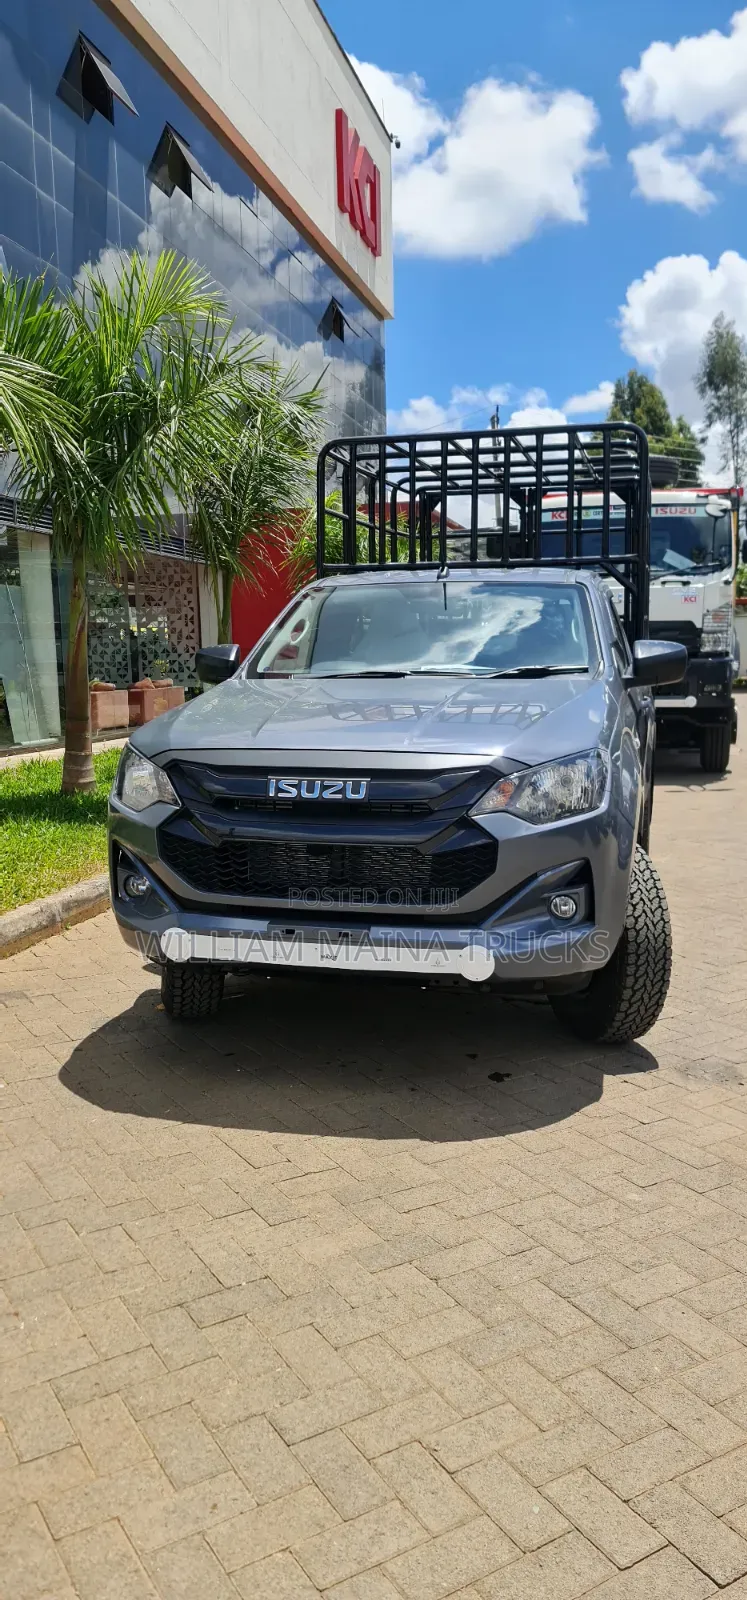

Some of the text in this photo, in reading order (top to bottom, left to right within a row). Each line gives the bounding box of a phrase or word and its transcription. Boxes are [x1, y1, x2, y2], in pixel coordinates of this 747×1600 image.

[335, 108, 381, 257] KCI
[551, 511, 568, 520] KC
[654, 507, 697, 515] ISUZU
[268, 779, 367, 799] ISUZU
